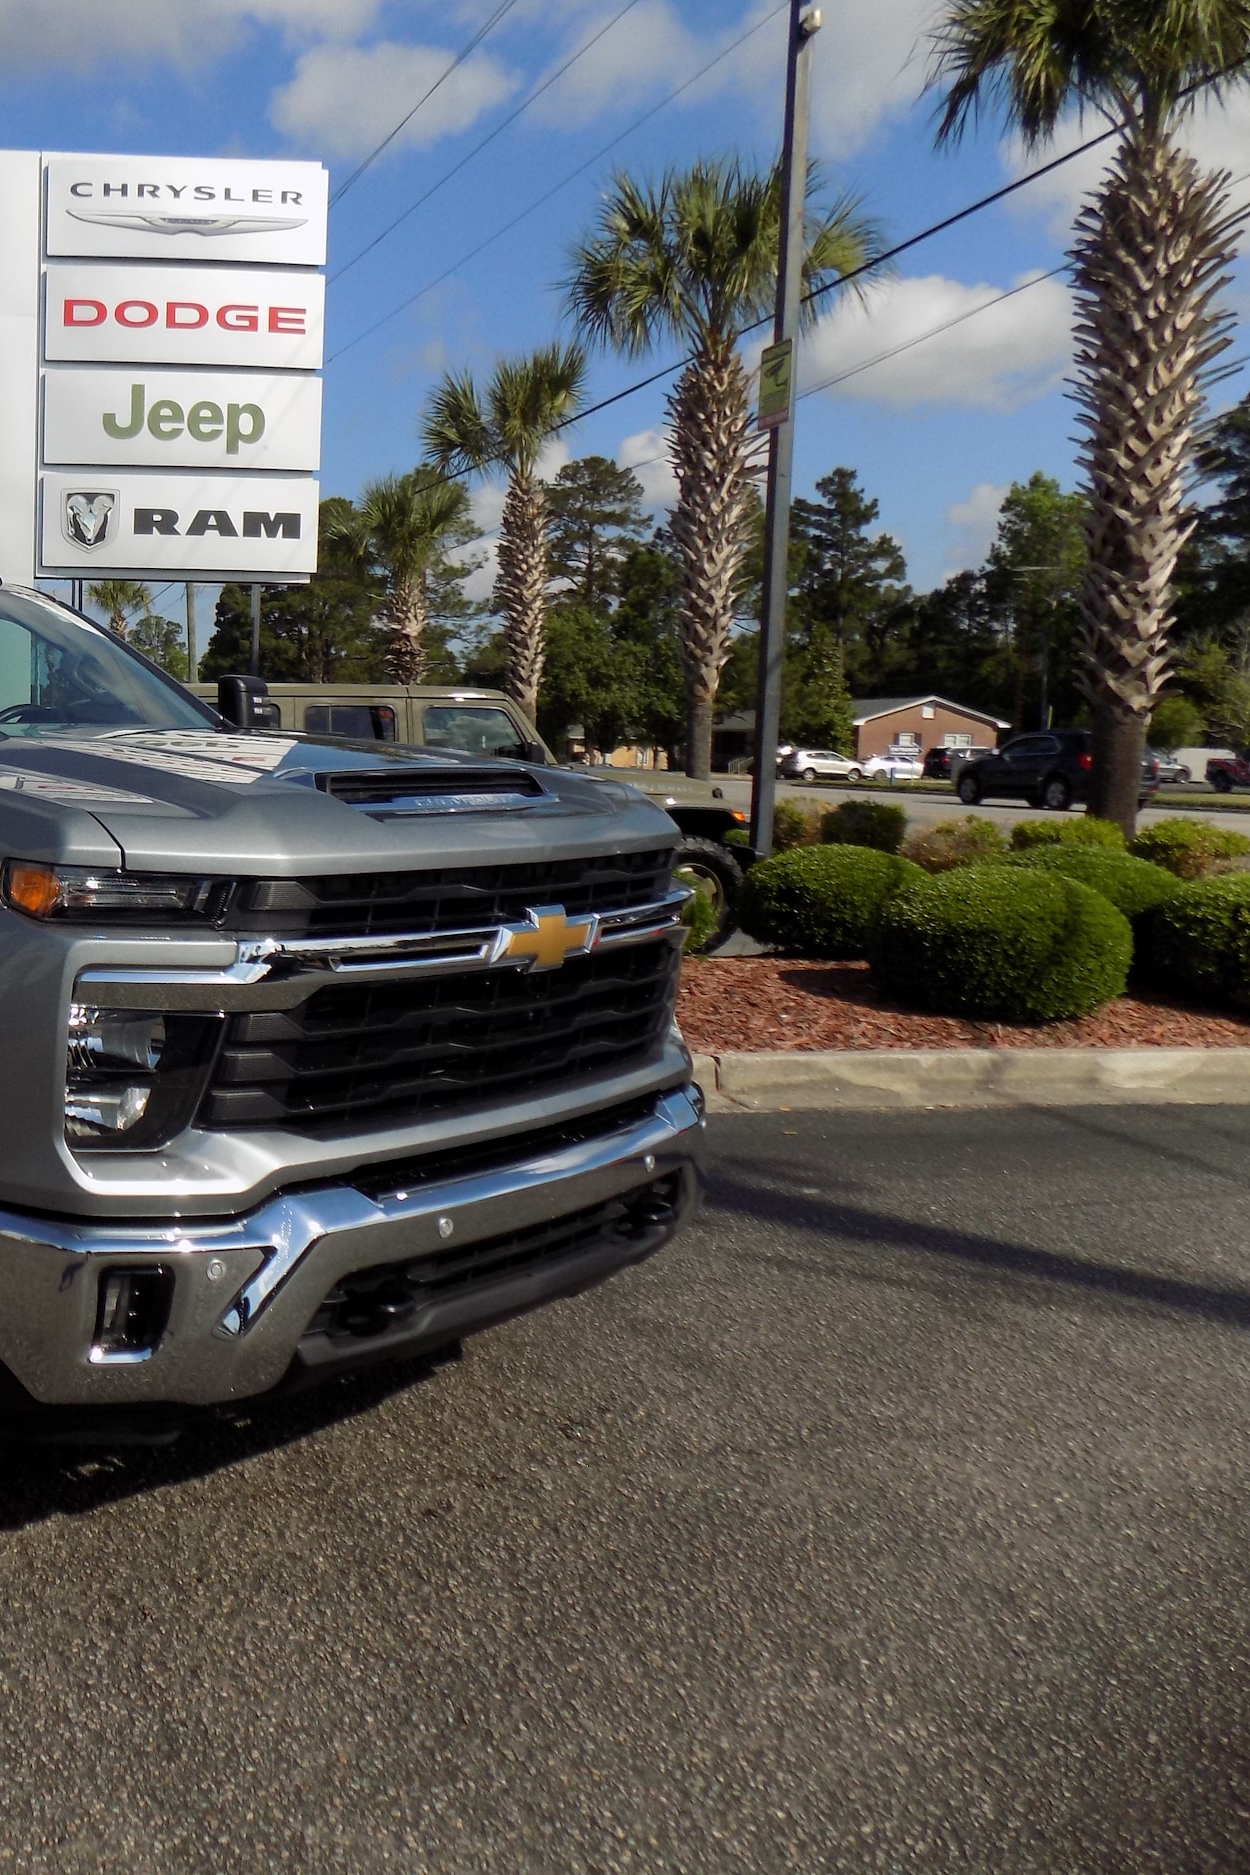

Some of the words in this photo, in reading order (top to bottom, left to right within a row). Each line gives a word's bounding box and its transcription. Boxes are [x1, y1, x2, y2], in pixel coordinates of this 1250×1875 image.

[70, 182, 303, 206] CHRYSLER
[63, 299, 307, 335] DODGE
[102, 383, 266, 455] Jeep
[133, 508, 301, 540] RAM
